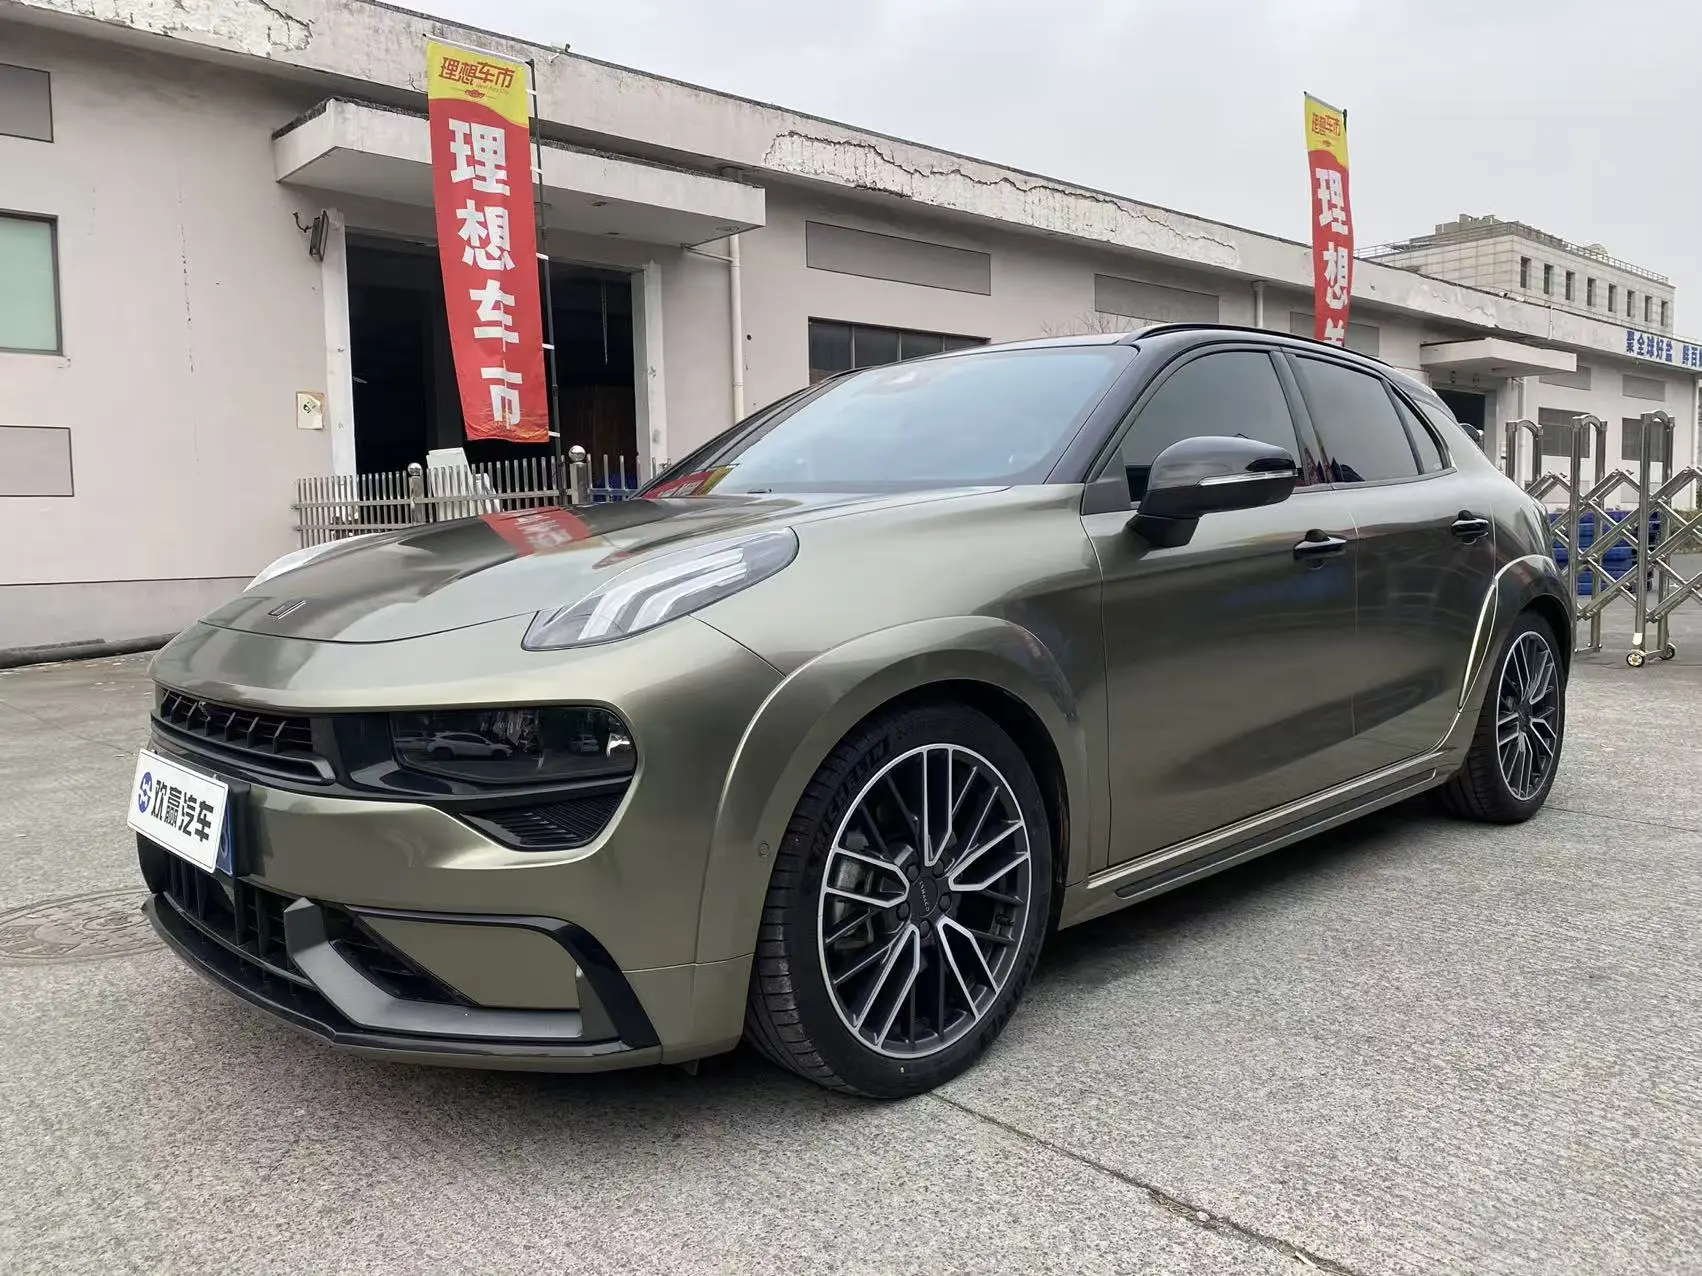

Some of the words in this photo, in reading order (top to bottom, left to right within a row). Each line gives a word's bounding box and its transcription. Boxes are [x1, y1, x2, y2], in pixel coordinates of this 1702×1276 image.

[438, 56, 515, 89] 理想车市
[448, 118, 523, 430] 理想车市
[151, 779, 214, 843] 欢赢汽车
